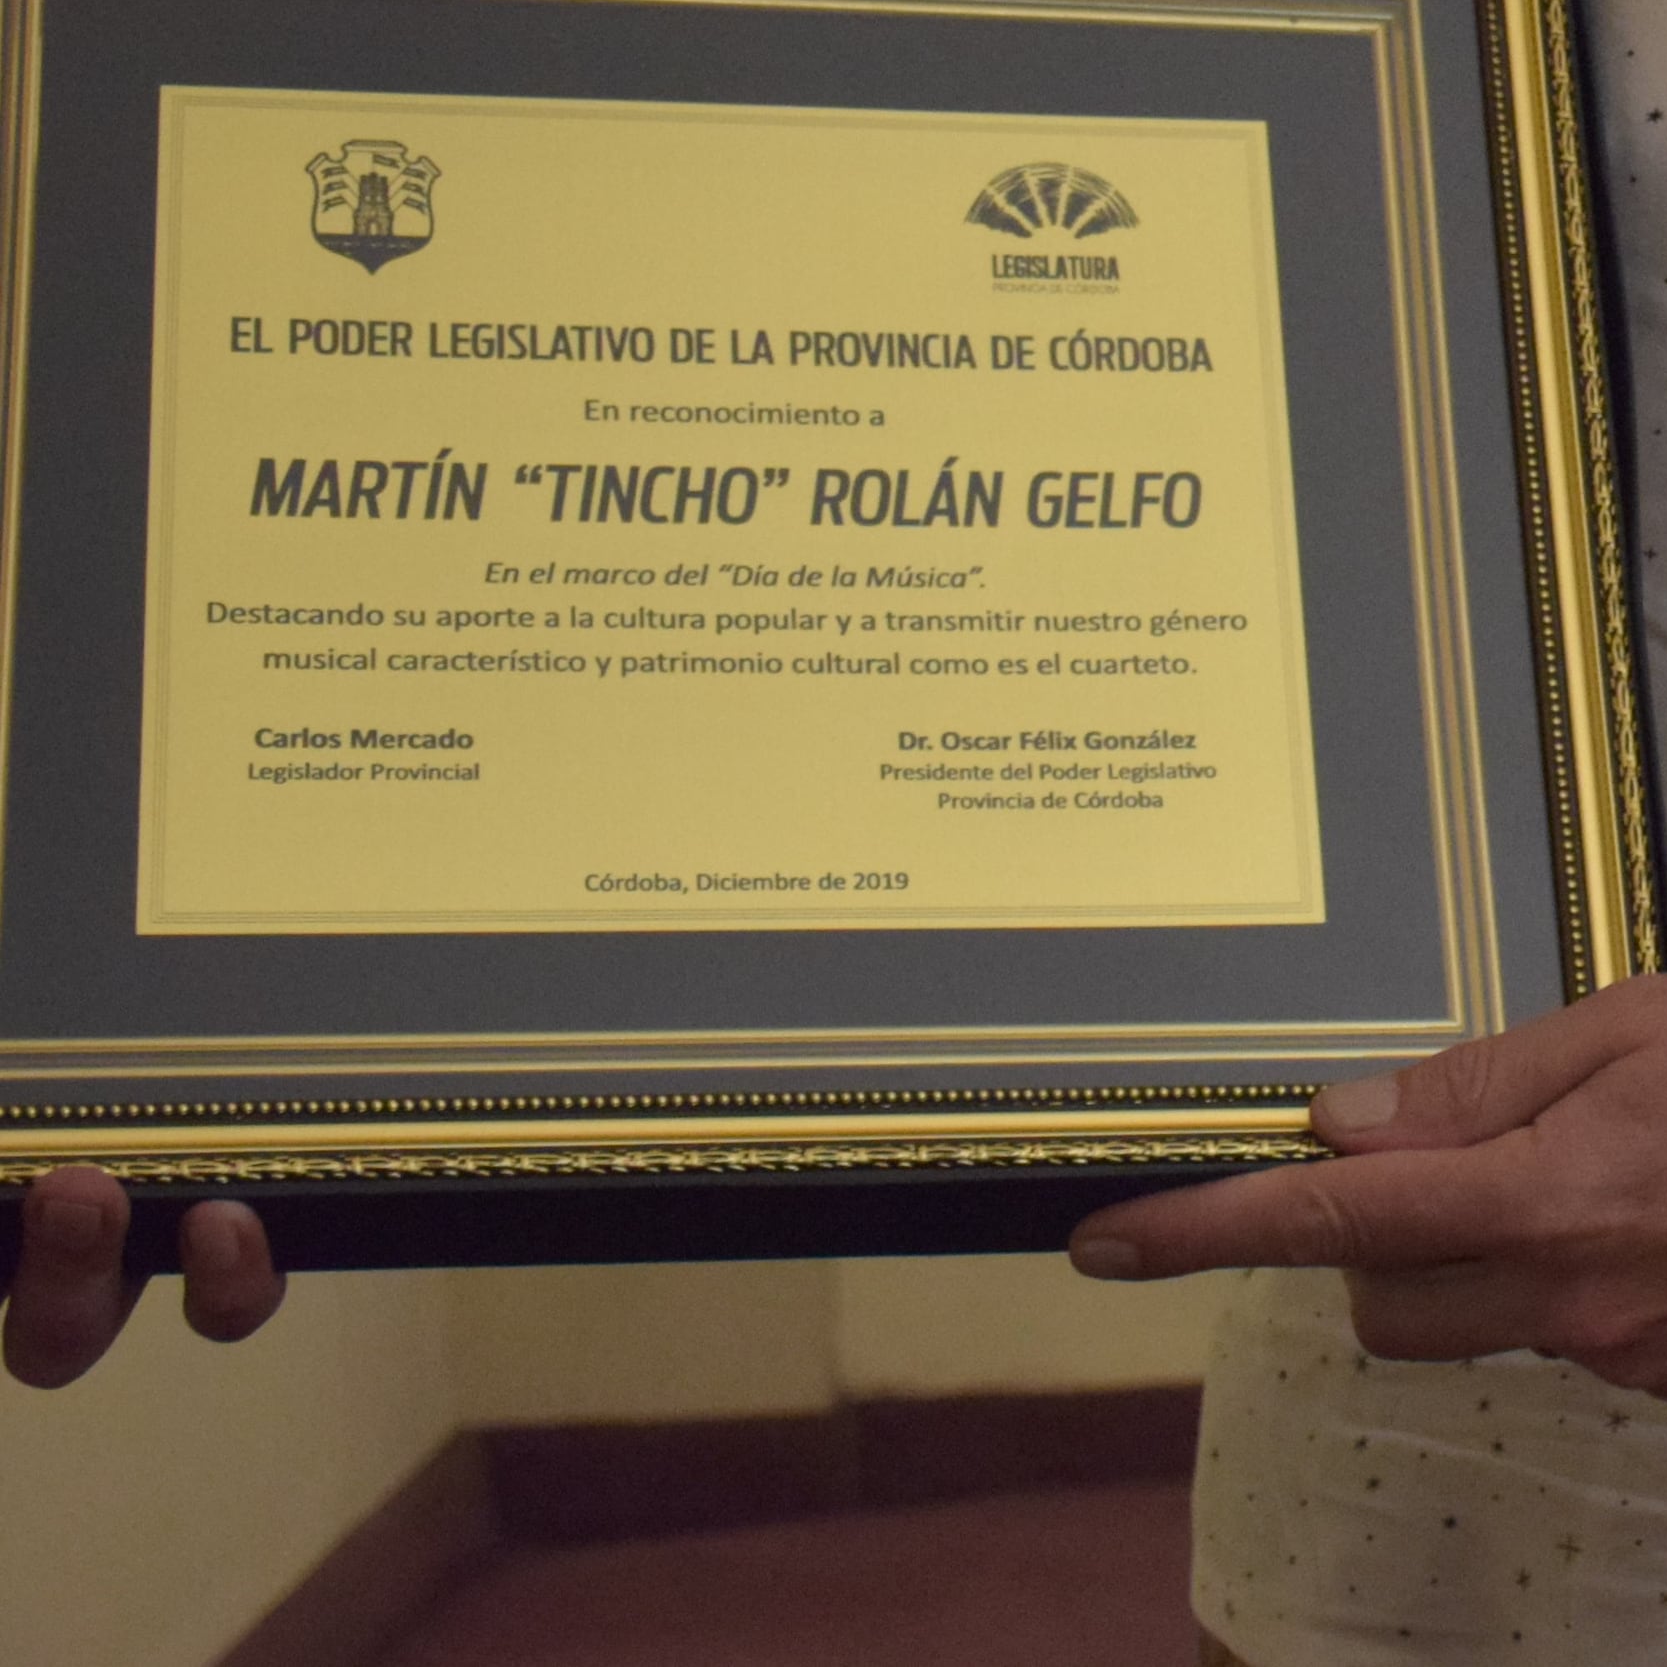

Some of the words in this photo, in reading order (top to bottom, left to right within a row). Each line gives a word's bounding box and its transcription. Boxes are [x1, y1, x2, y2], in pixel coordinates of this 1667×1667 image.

[991, 253, 1120, 280] LEGISLATURA
[229, 315, 273, 353] EL
[288, 317, 413, 357] PODER
[429, 321, 655, 363] LEGISLATIVO
[669, 327, 715, 364] DE
[730, 328, 774, 365] LA
[789, 330, 976, 369] PROVINCIA
[990, 334, 1035, 370] DE
[1048, 327, 1213, 372] CÓRDOBA
[583, 398, 619, 421] En
[629, 401, 860, 426] reconocimiento
[869, 409, 885, 426] a
[249, 447, 488, 520] MARTÍN
[809, 455, 1004, 527] ROLÁN
[1026, 470, 1202, 528] GELFO
[484, 561, 520, 583] En
[528, 561, 555, 584] el
[562, 567, 656, 585] marco
[663, 563, 709, 586] del
[787, 564, 823, 587] de
[830, 564, 857, 587] la
[206, 600, 384, 626] Destacando
[393, 609, 425, 626] su
[435, 607, 535, 632] aporte
[544, 611, 560, 628] a
[570, 605, 594, 628] la
[602, 605, 705, 629] cultura
[715, 607, 827, 635] popular
[835, 614, 852, 635] y
[860, 614, 876, 630] a
[884, 610, 1025, 631] transmitir
[1033, 612, 1141, 632] nuestro
[1149, 608, 1247, 637] género
[262, 646, 376, 670] musical
[386, 648, 586, 672] característico
[594, 655, 612, 678] y
[620, 650, 783, 677] patrimonio
[791, 651, 900, 674] cultural
[908, 657, 989, 675] como
[996, 658, 1028, 675] es
[1036, 652, 1060, 675] el
[1069, 654, 1197, 675] cuarteto.
[254, 726, 342, 749] Carlos
[349, 727, 474, 749] Mercado
[897, 731, 933, 751] Dr.
[940, 731, 1012, 751] Oscar
[1019, 729, 1077, 751] Félix
[1082, 728, 1196, 750] González
[247, 761, 364, 784] Legislador
[370, 762, 480, 781] Provincial
[879, 762, 994, 781] Presidente
[999, 762, 1033, 781] del
[1038, 762, 1101, 780] Poder
[1106, 761, 1217, 784] Legislativo
[937, 792, 1036, 809] Provincia
[1040, 791, 1067, 809] de
[1072, 790, 1164, 809] Córdoba
[584, 872, 688, 894] Córdoba,
[695, 872, 811, 891] Diciembre
[817, 871, 846, 891] de
[853, 871, 909, 890] 2019
